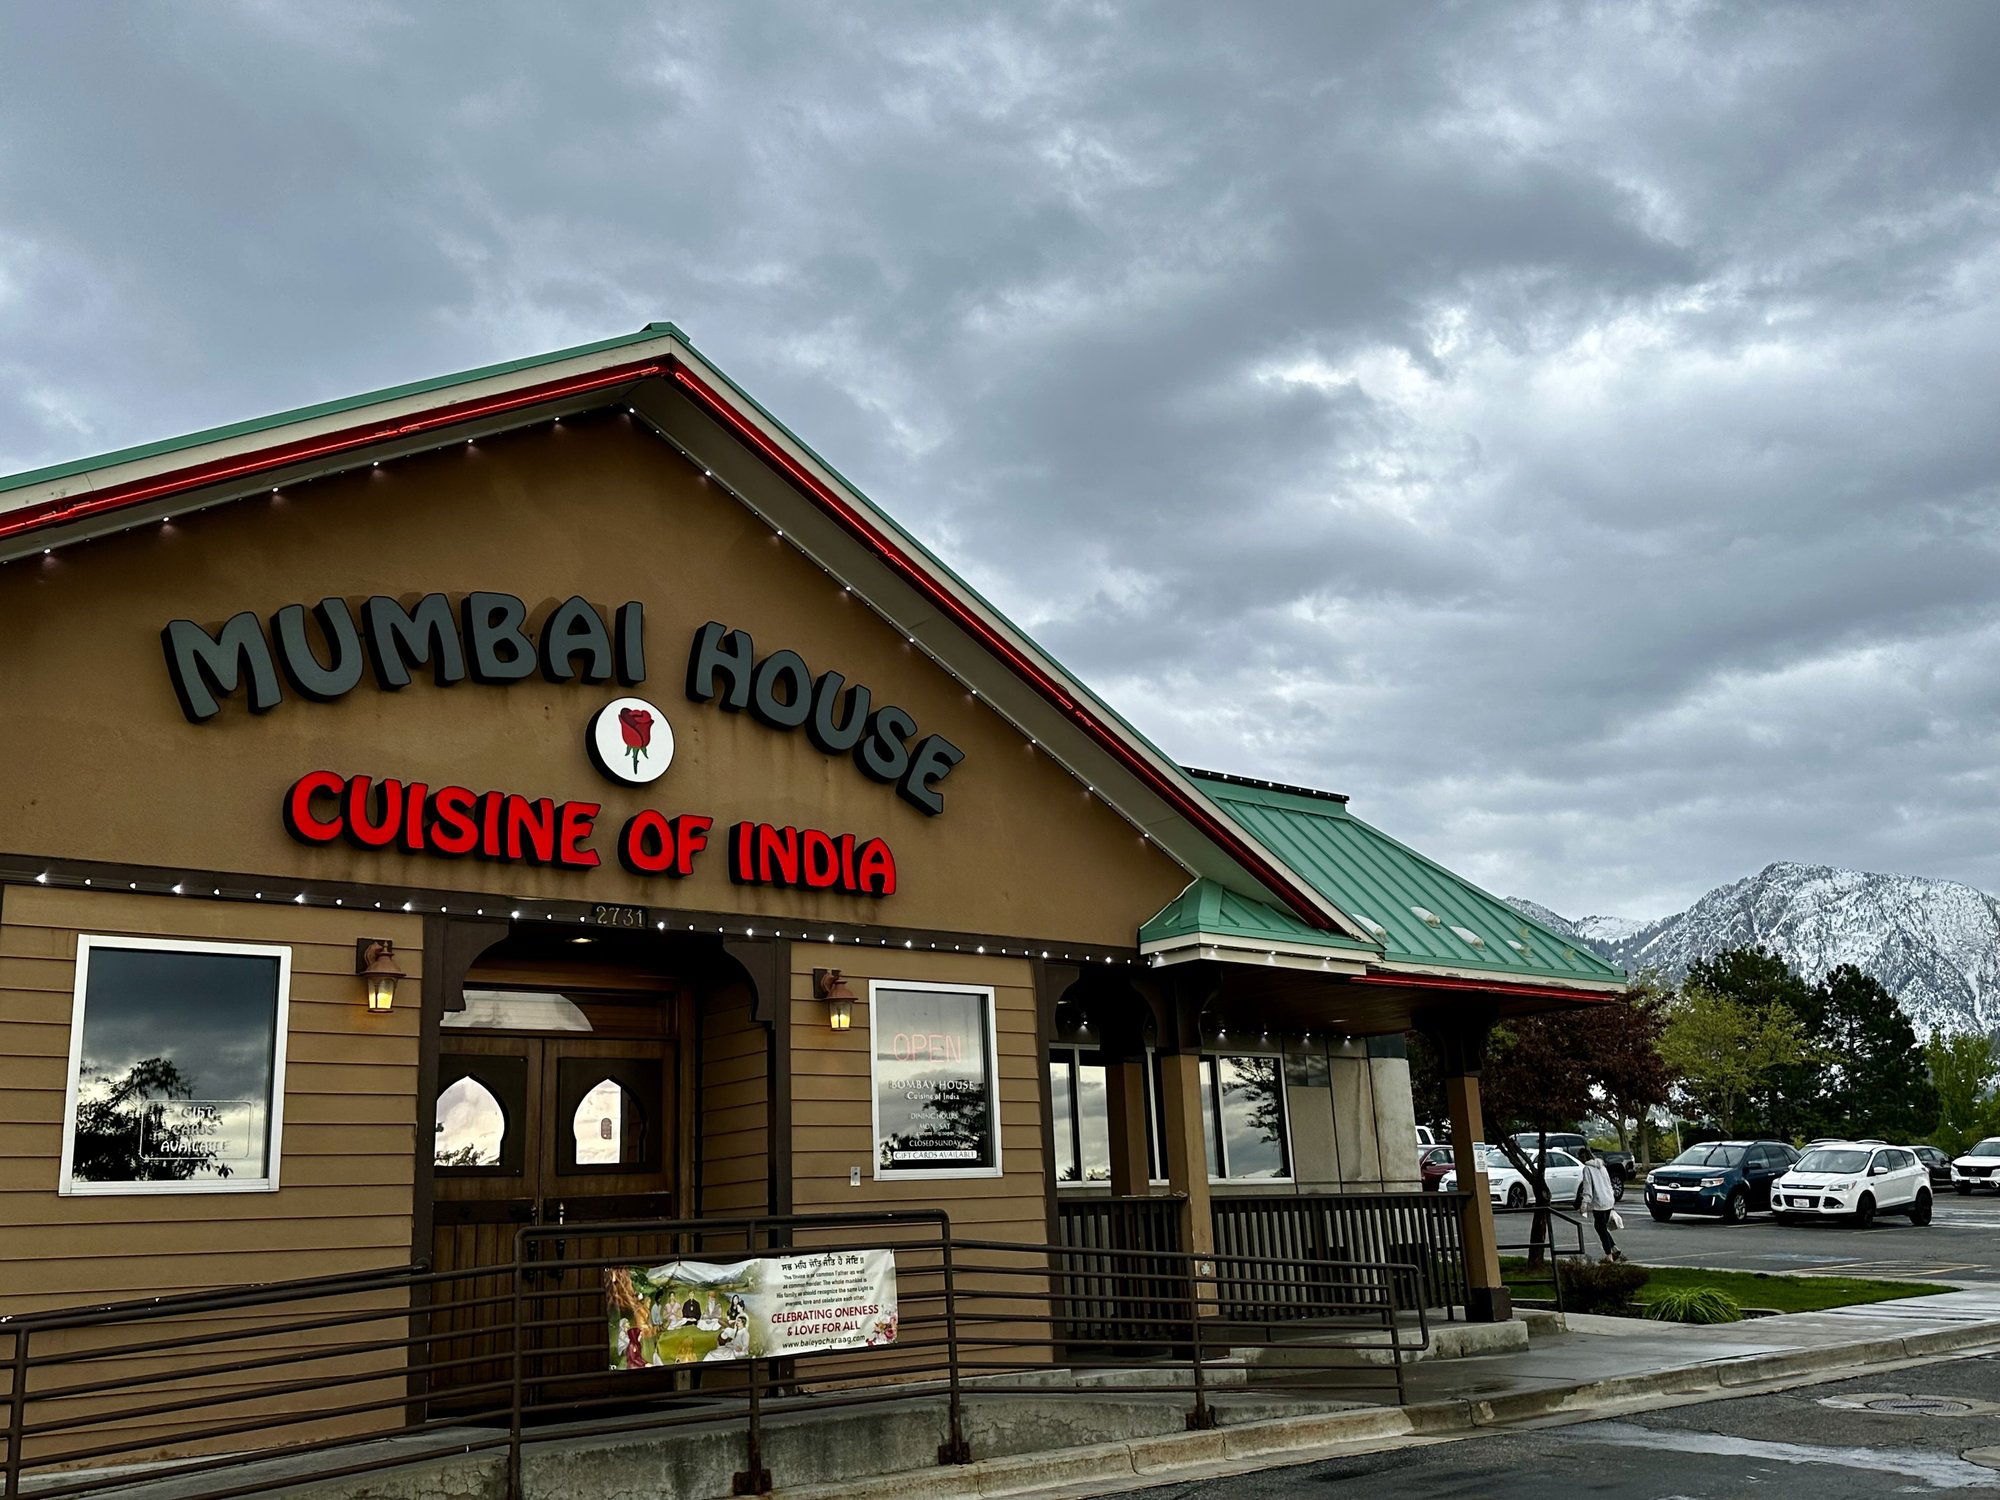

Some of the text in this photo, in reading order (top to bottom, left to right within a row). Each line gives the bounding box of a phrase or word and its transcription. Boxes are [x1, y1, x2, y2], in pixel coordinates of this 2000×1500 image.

[163, 591, 965, 815] MUMBAI HOUSE
[283, 770, 898, 897] CUISINE OF INDIA
[596, 905, 643, 927] 2731
[893, 1032, 962, 1065] OPEN
[890, 1080, 975, 1090] BOMBAY HOUSE
[906, 1091, 960, 1101] Cuisine of India
[181, 1105, 215, 1119] GIFT
[910, 1111, 959, 1120] DINING HOURS
[171, 1124, 217, 1136] CARDS
[161, 1140, 231, 1153] AVAILABLE
[935, 1140, 960, 1148] SUNDAY
[939, 1151, 975, 1159] AVAILABLE
[817, 1288, 838, 1296] recognize
[858, 1285, 869, 1293] Light
[822, 1295, 843, 1304] celebrate
[771, 1304, 879, 1324] CELEBRATING ONENESS
[787, 1320, 861, 1337] & LOVE FOR ALL
